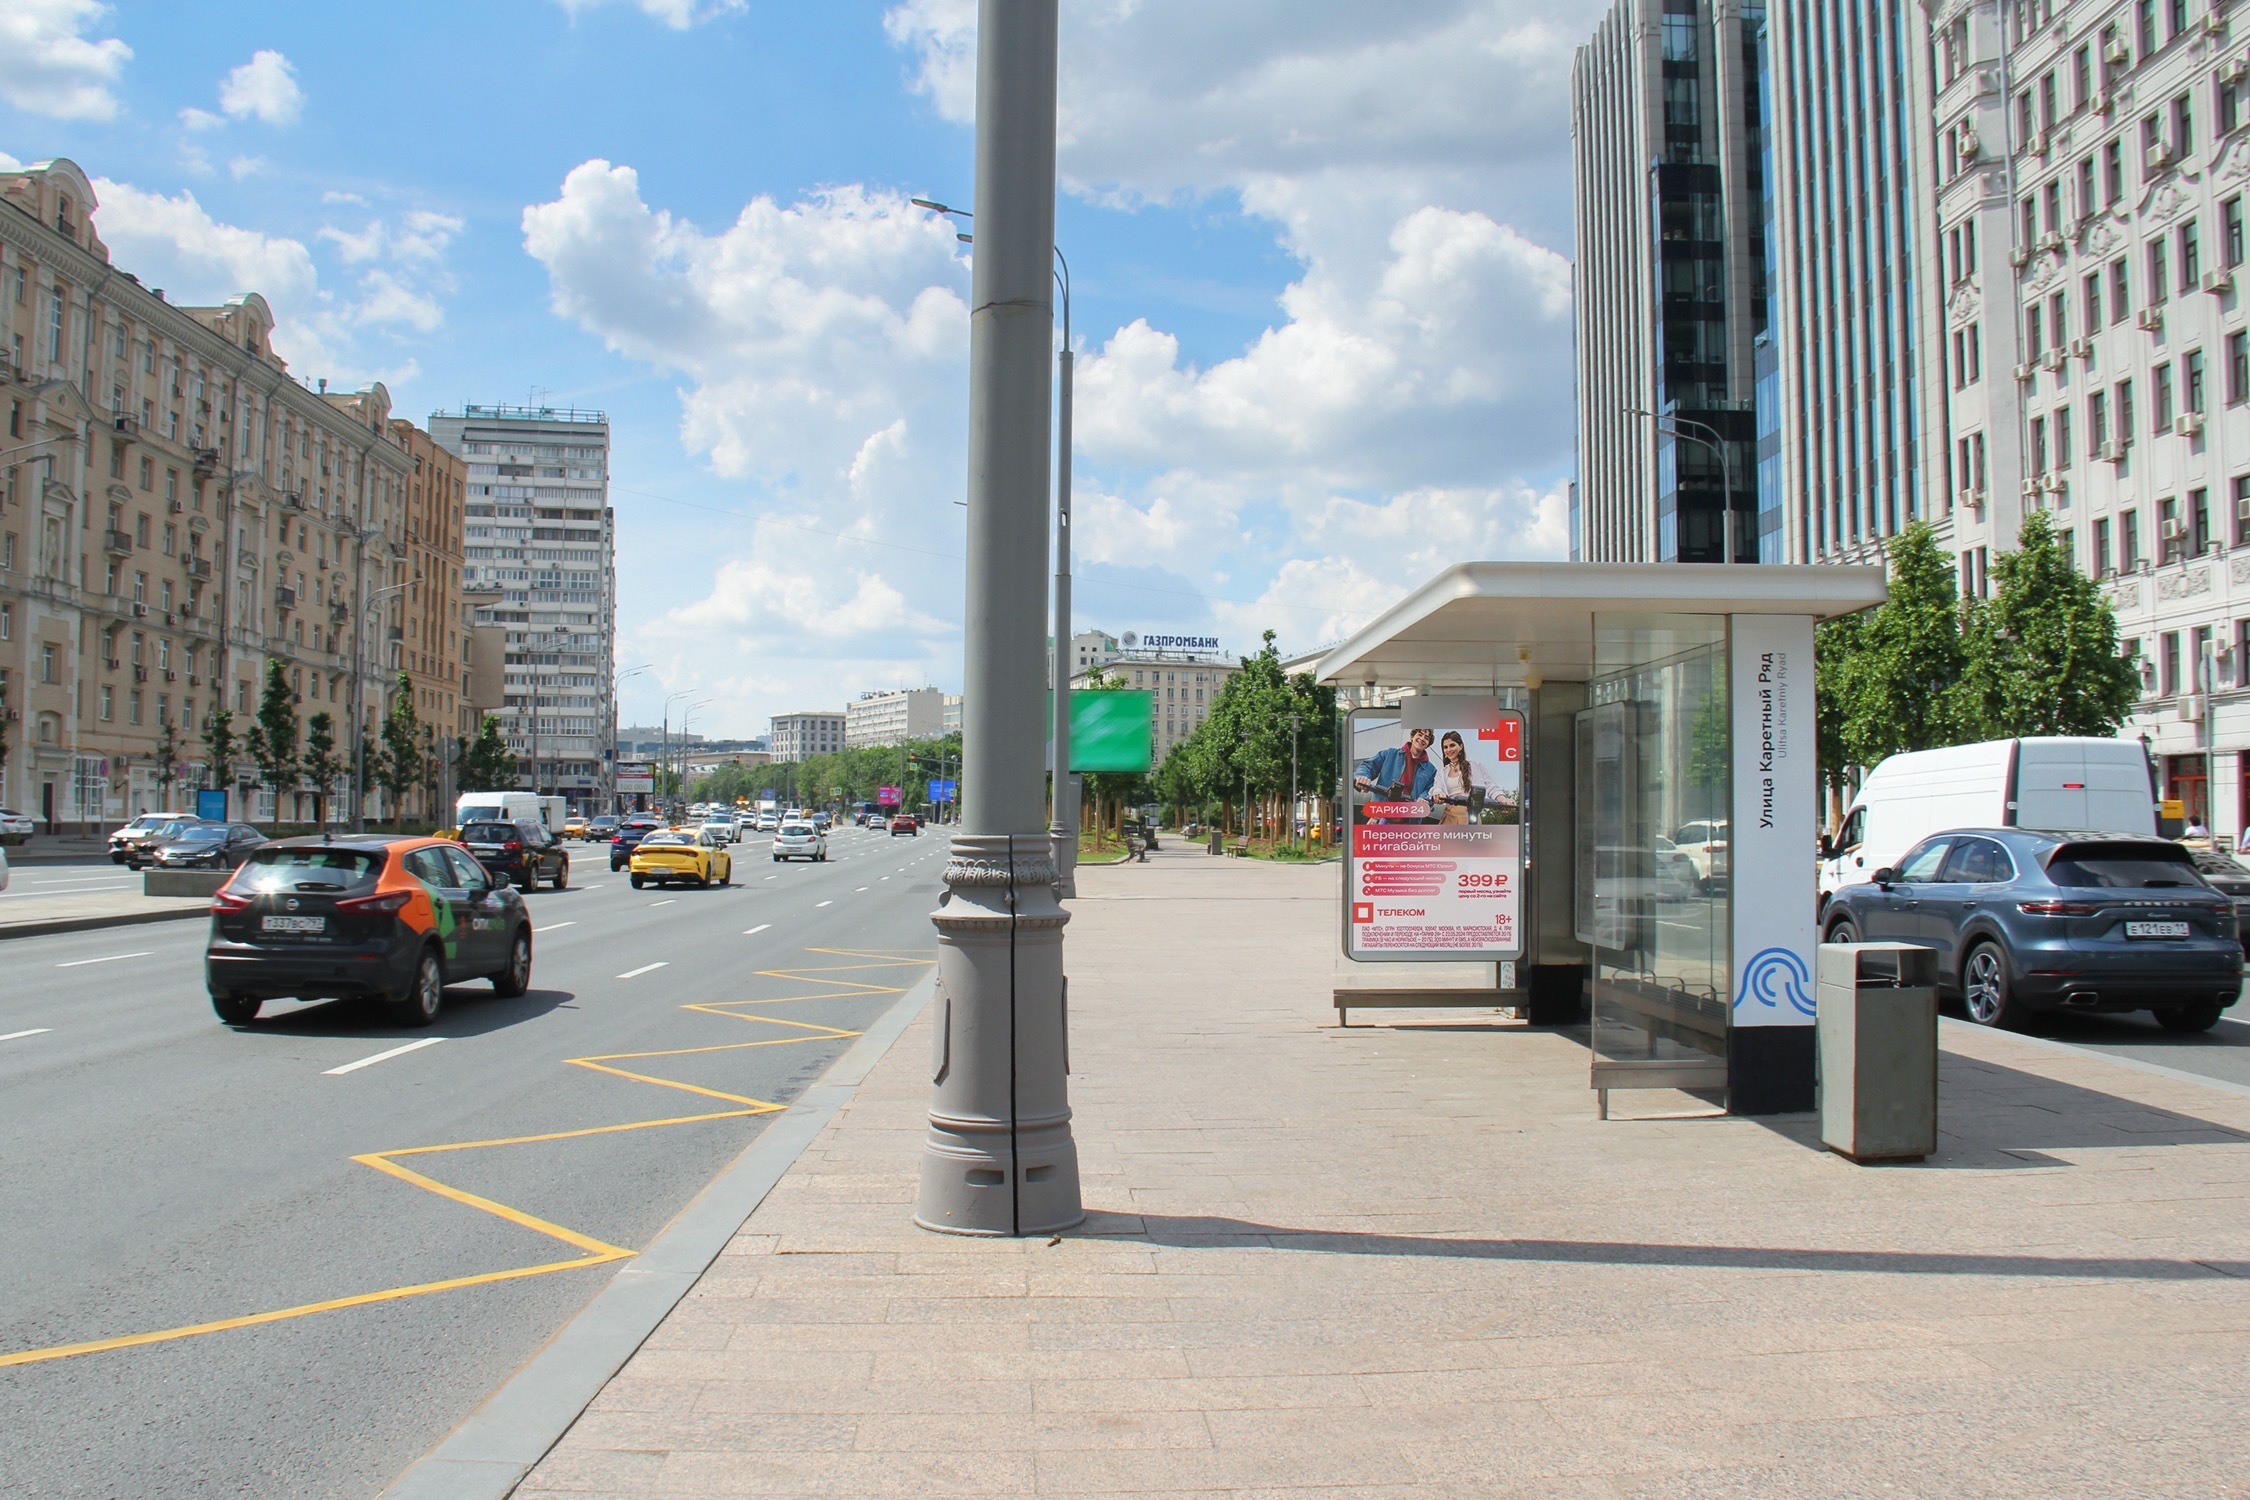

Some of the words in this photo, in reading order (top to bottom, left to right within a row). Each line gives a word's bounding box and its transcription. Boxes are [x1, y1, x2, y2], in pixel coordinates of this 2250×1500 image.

[1144, 635, 1219, 648] ГАЗПРОМБАНК
[1758, 653, 1773, 682] Ряд
[1776, 652, 1788, 678] Ryad
[1777, 682, 1788, 726] Karetniy
[1758, 690, 1775, 771] Каретный
[1778, 729, 1787, 758] Ulitsa
[1370, 805, 1409, 814] ТАРИФ
[1760, 778, 1775, 828] Улица
[1362, 830, 1440, 841] Переносите
[1443, 832, 1492, 841] минуты
[1373, 841, 1440, 851] гигабайты
[1458, 875, 1492, 886] 399
[1495, 914, 1512, 924] 18+
